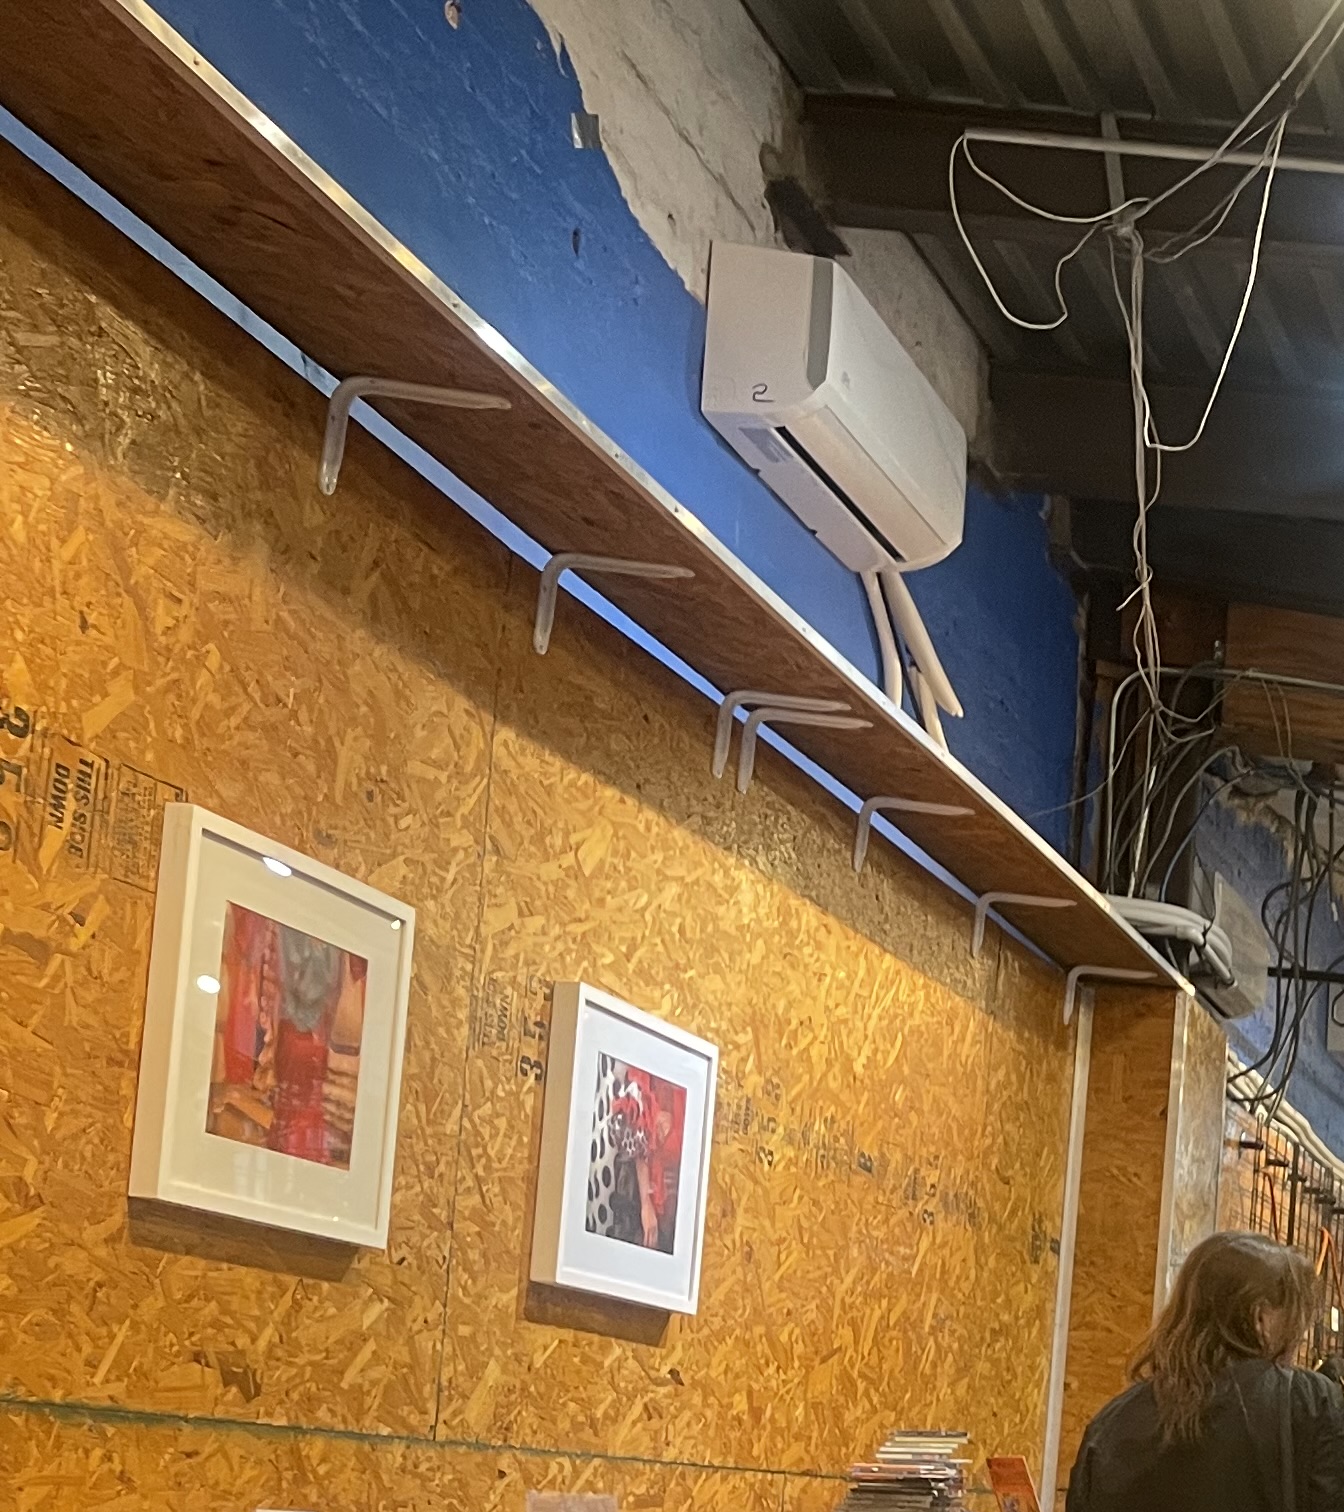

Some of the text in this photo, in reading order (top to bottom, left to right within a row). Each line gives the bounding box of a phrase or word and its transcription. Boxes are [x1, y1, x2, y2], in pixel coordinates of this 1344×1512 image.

[751, 382, 776, 404] 2
[48, 762, 71, 832] DOWN
[73, 756, 96, 807] THIS
